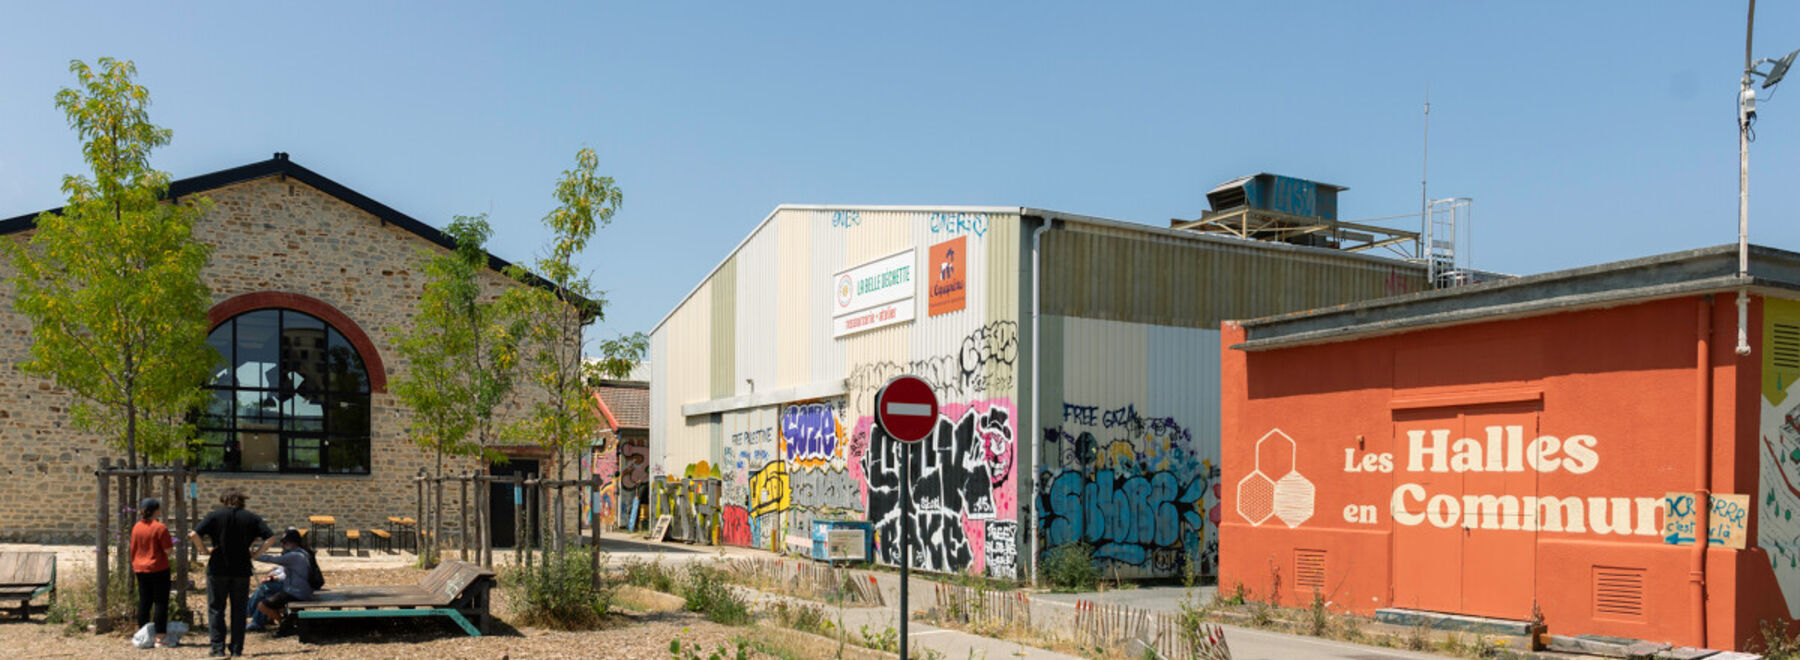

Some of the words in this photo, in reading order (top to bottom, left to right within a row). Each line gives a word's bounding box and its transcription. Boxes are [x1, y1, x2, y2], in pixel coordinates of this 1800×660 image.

[857, 279, 864, 296] LA
[865, 274, 880, 293] BELLE
[1063, 403, 1099, 426] FREE
[1102, 403, 1142, 429] GAZA
[1343, 448, 1394, 473] Les
[1406, 425, 1600, 475] Halles
[1343, 504, 1378, 524] en
[1390, 483, 1666, 536] Commun
